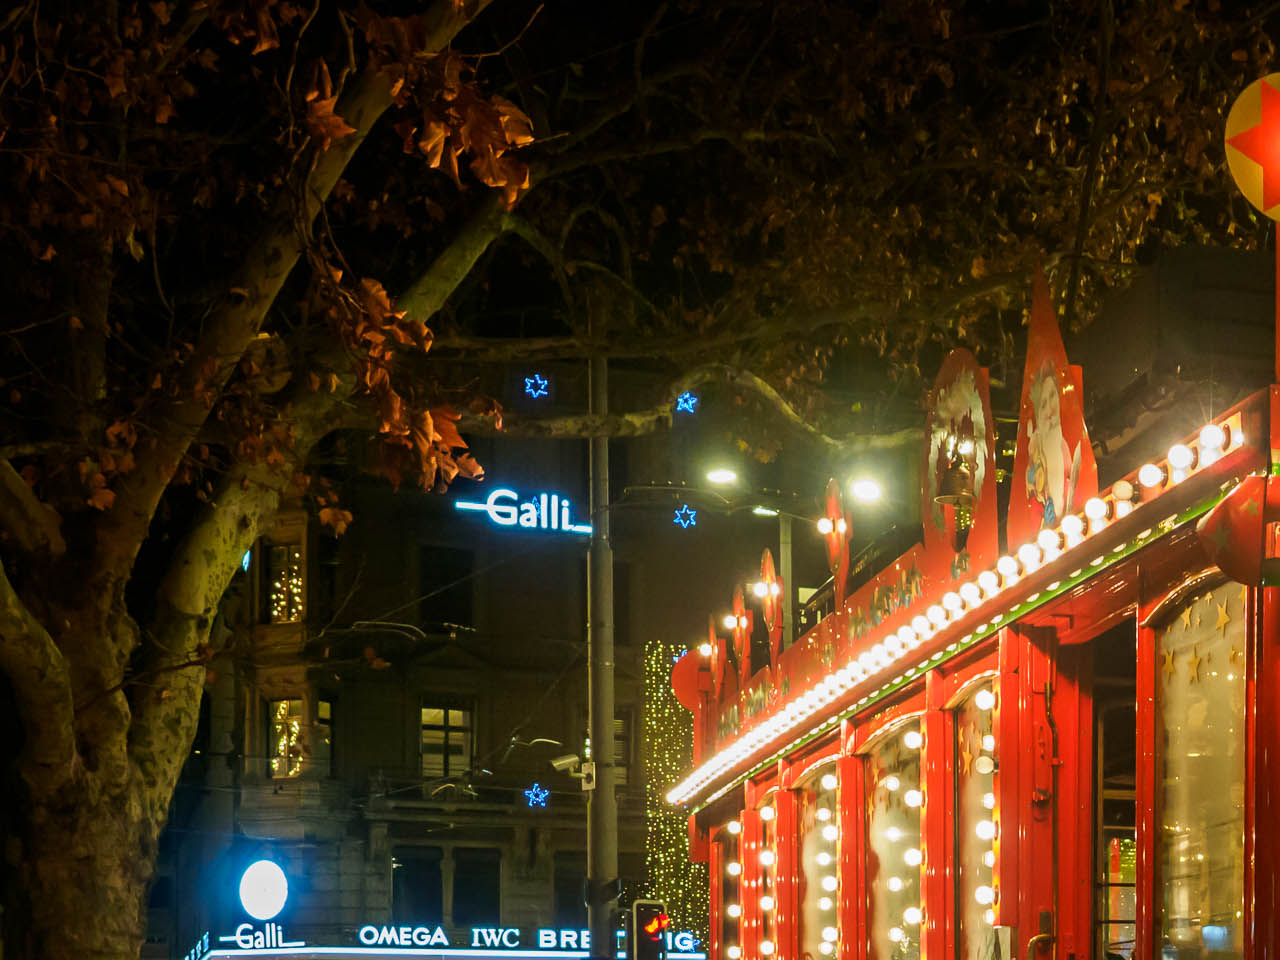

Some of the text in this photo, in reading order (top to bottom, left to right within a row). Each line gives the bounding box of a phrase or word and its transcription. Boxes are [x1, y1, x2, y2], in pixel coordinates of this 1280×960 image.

[455, 489, 592, 533] Galli
[219, 923, 305, 949] Galli
[359, 926, 449, 945] OMEGA
[472, 928, 520, 947] IWC
